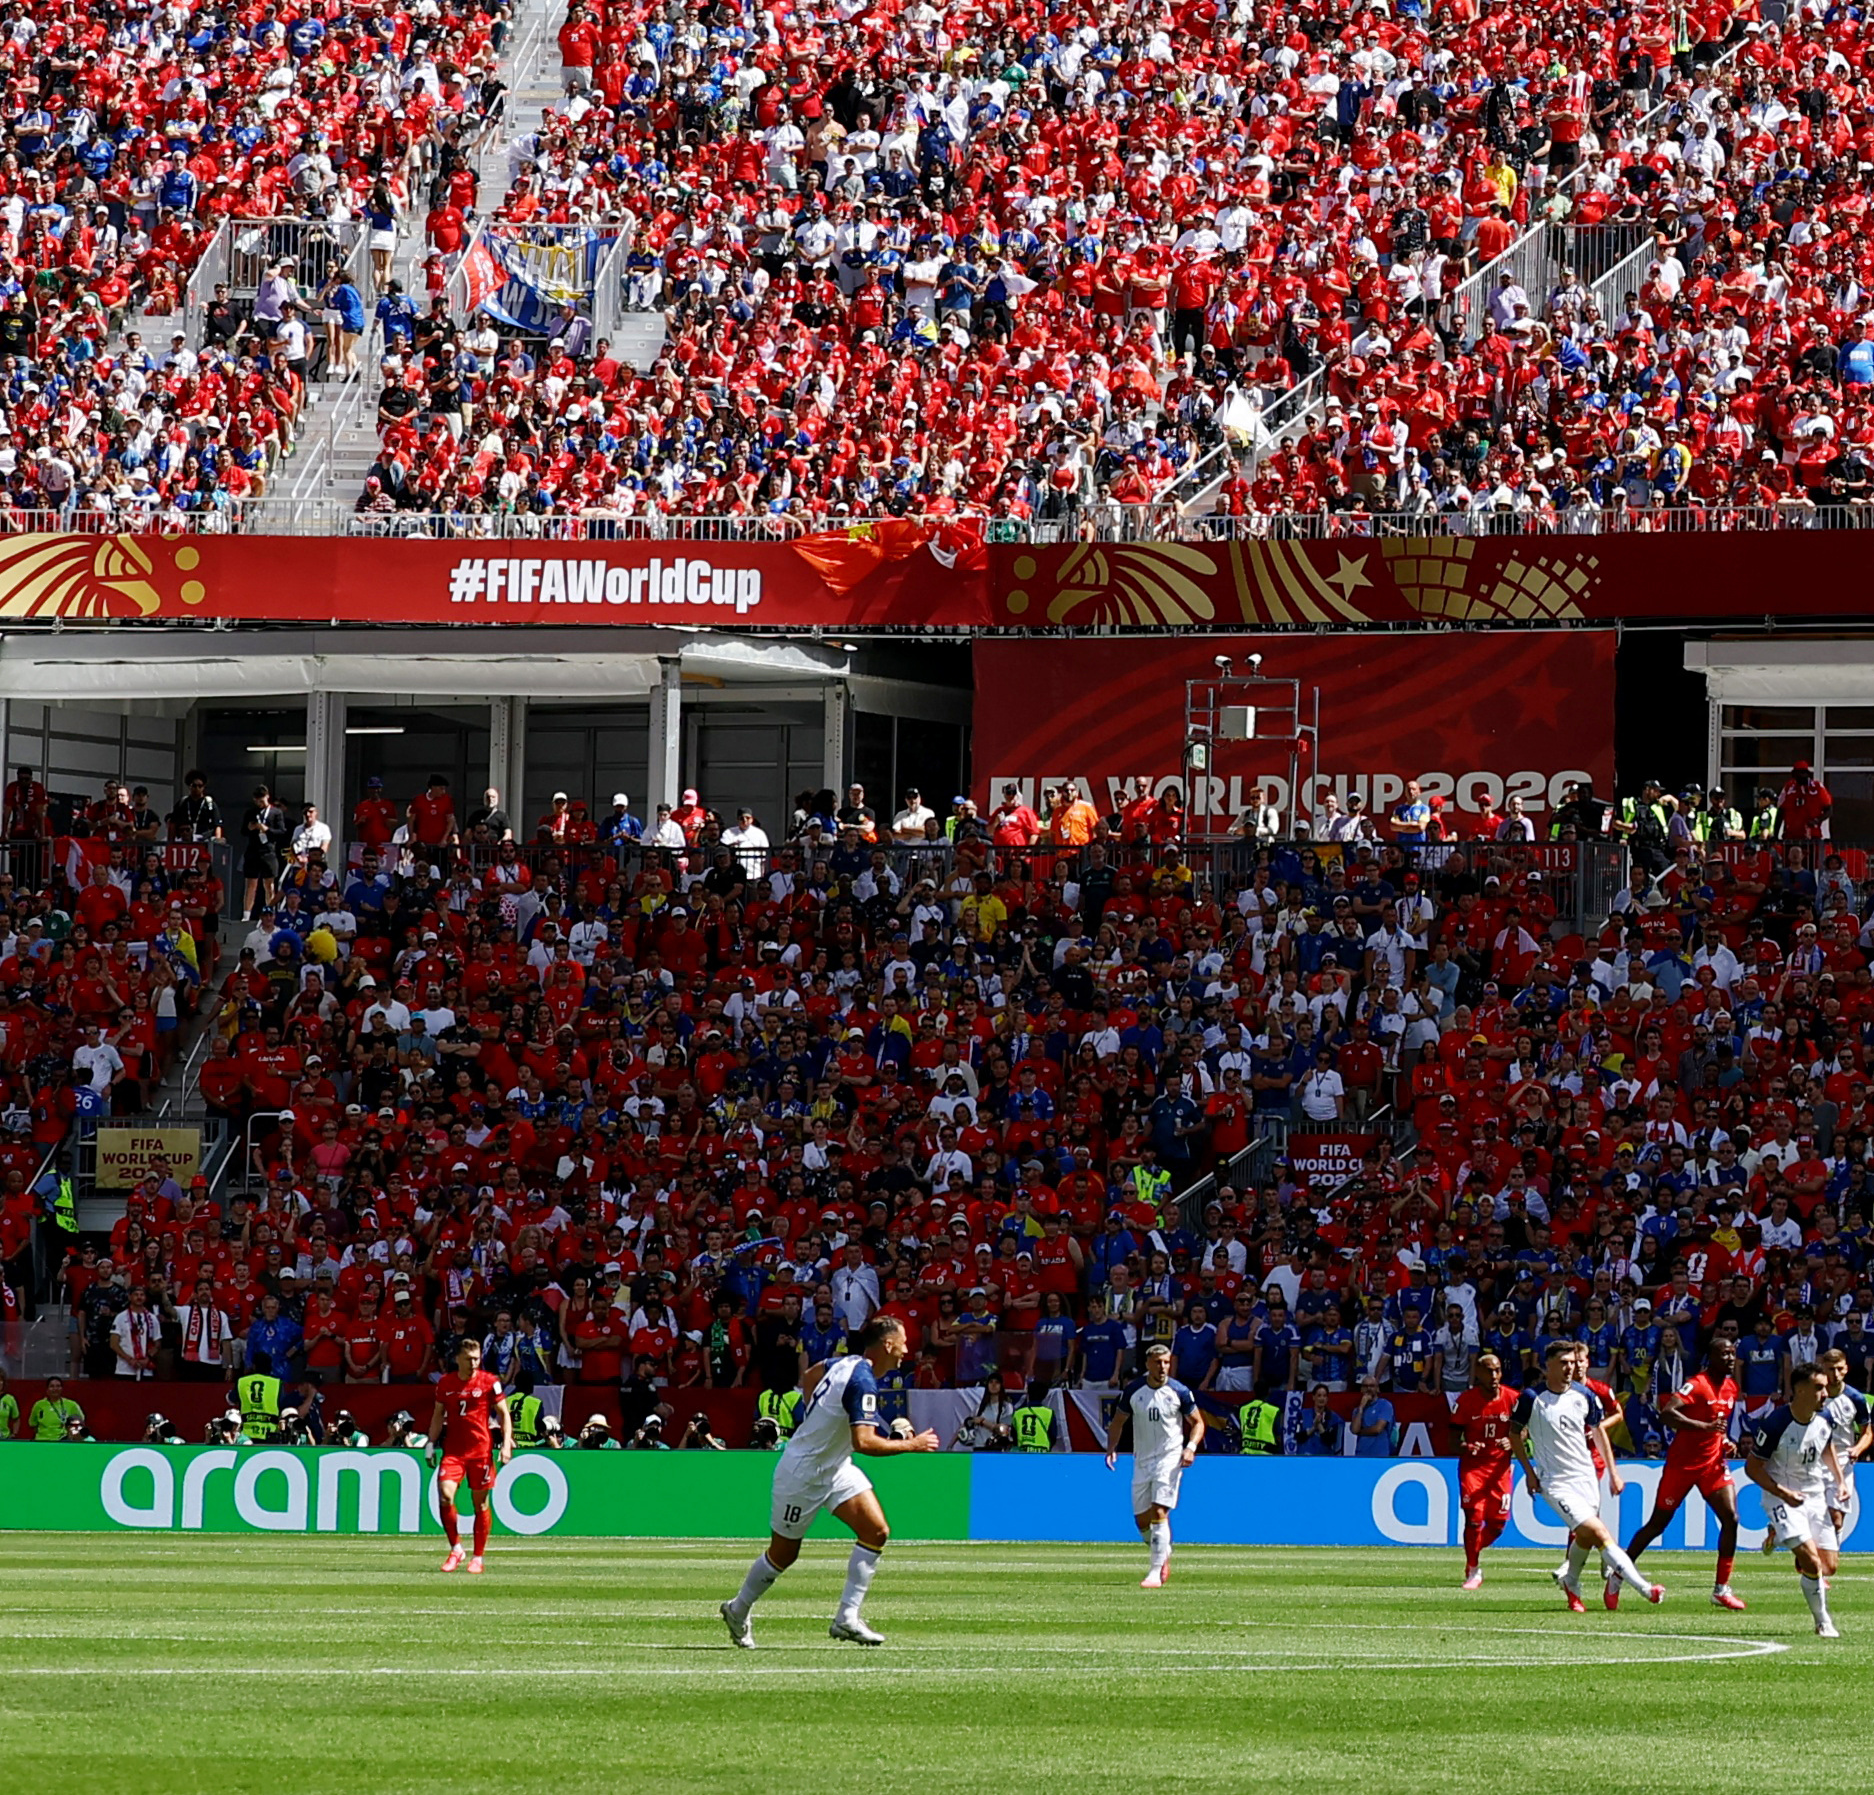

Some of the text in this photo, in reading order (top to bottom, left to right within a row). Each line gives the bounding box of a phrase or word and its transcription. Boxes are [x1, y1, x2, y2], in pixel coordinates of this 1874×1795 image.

[449, 556, 763, 614] #FIFAWorldCup
[1301, 773, 1404, 815] CUP
[1413, 769, 1592, 814] 2026
[172, 847, 200, 867] 112
[1543, 847, 1571, 867] 113
[130, 1138, 164, 1151] FIFA
[1319, 1143, 1352, 1157] FIFA
[1293, 1157, 1347, 1172] WORLD
[118, 1167, 174, 1180] 20
[1308, 1172, 1352, 1187] 202
[459, 1400, 468, 1416] 2
[1148, 1406, 1161, 1424] 10
[1483, 1422, 1497, 1439] 13
[1559, 1415, 1569, 1430] 6
[1801, 1447, 1816, 1465] 13
[483, 1464, 492, 1481] 2
[783, 1503, 802, 1524] 18
